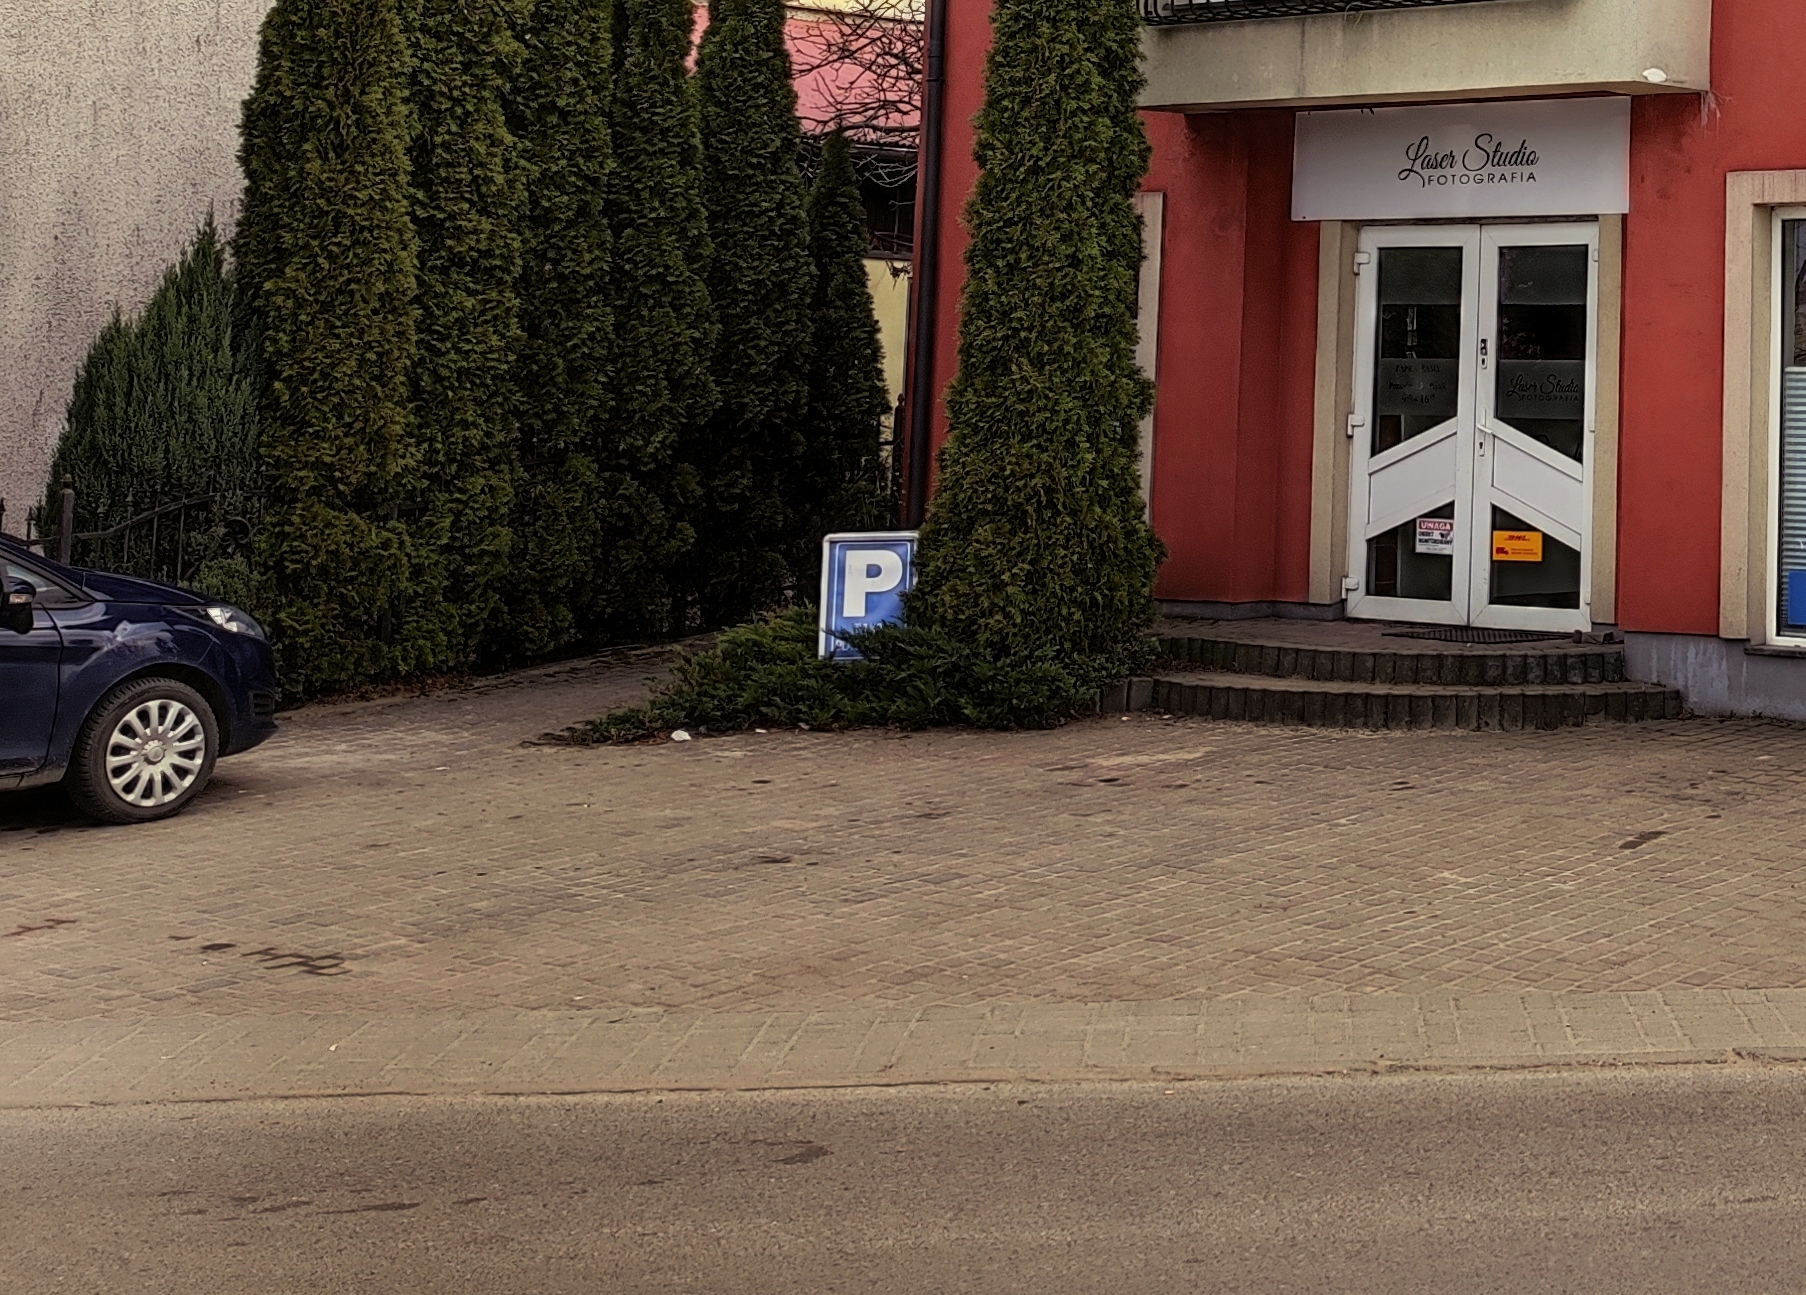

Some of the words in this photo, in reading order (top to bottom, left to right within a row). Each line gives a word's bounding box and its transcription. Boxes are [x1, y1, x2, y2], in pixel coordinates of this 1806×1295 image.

[1398, 136, 1457, 187] Laser
[1462, 133, 1539, 171] Studio
[1427, 172, 1537, 185] FOTOGRAFIA
[1506, 374, 1537, 402] Laser
[1421, 521, 1451, 531] UWAGA
[843, 550, 903, 617] P
